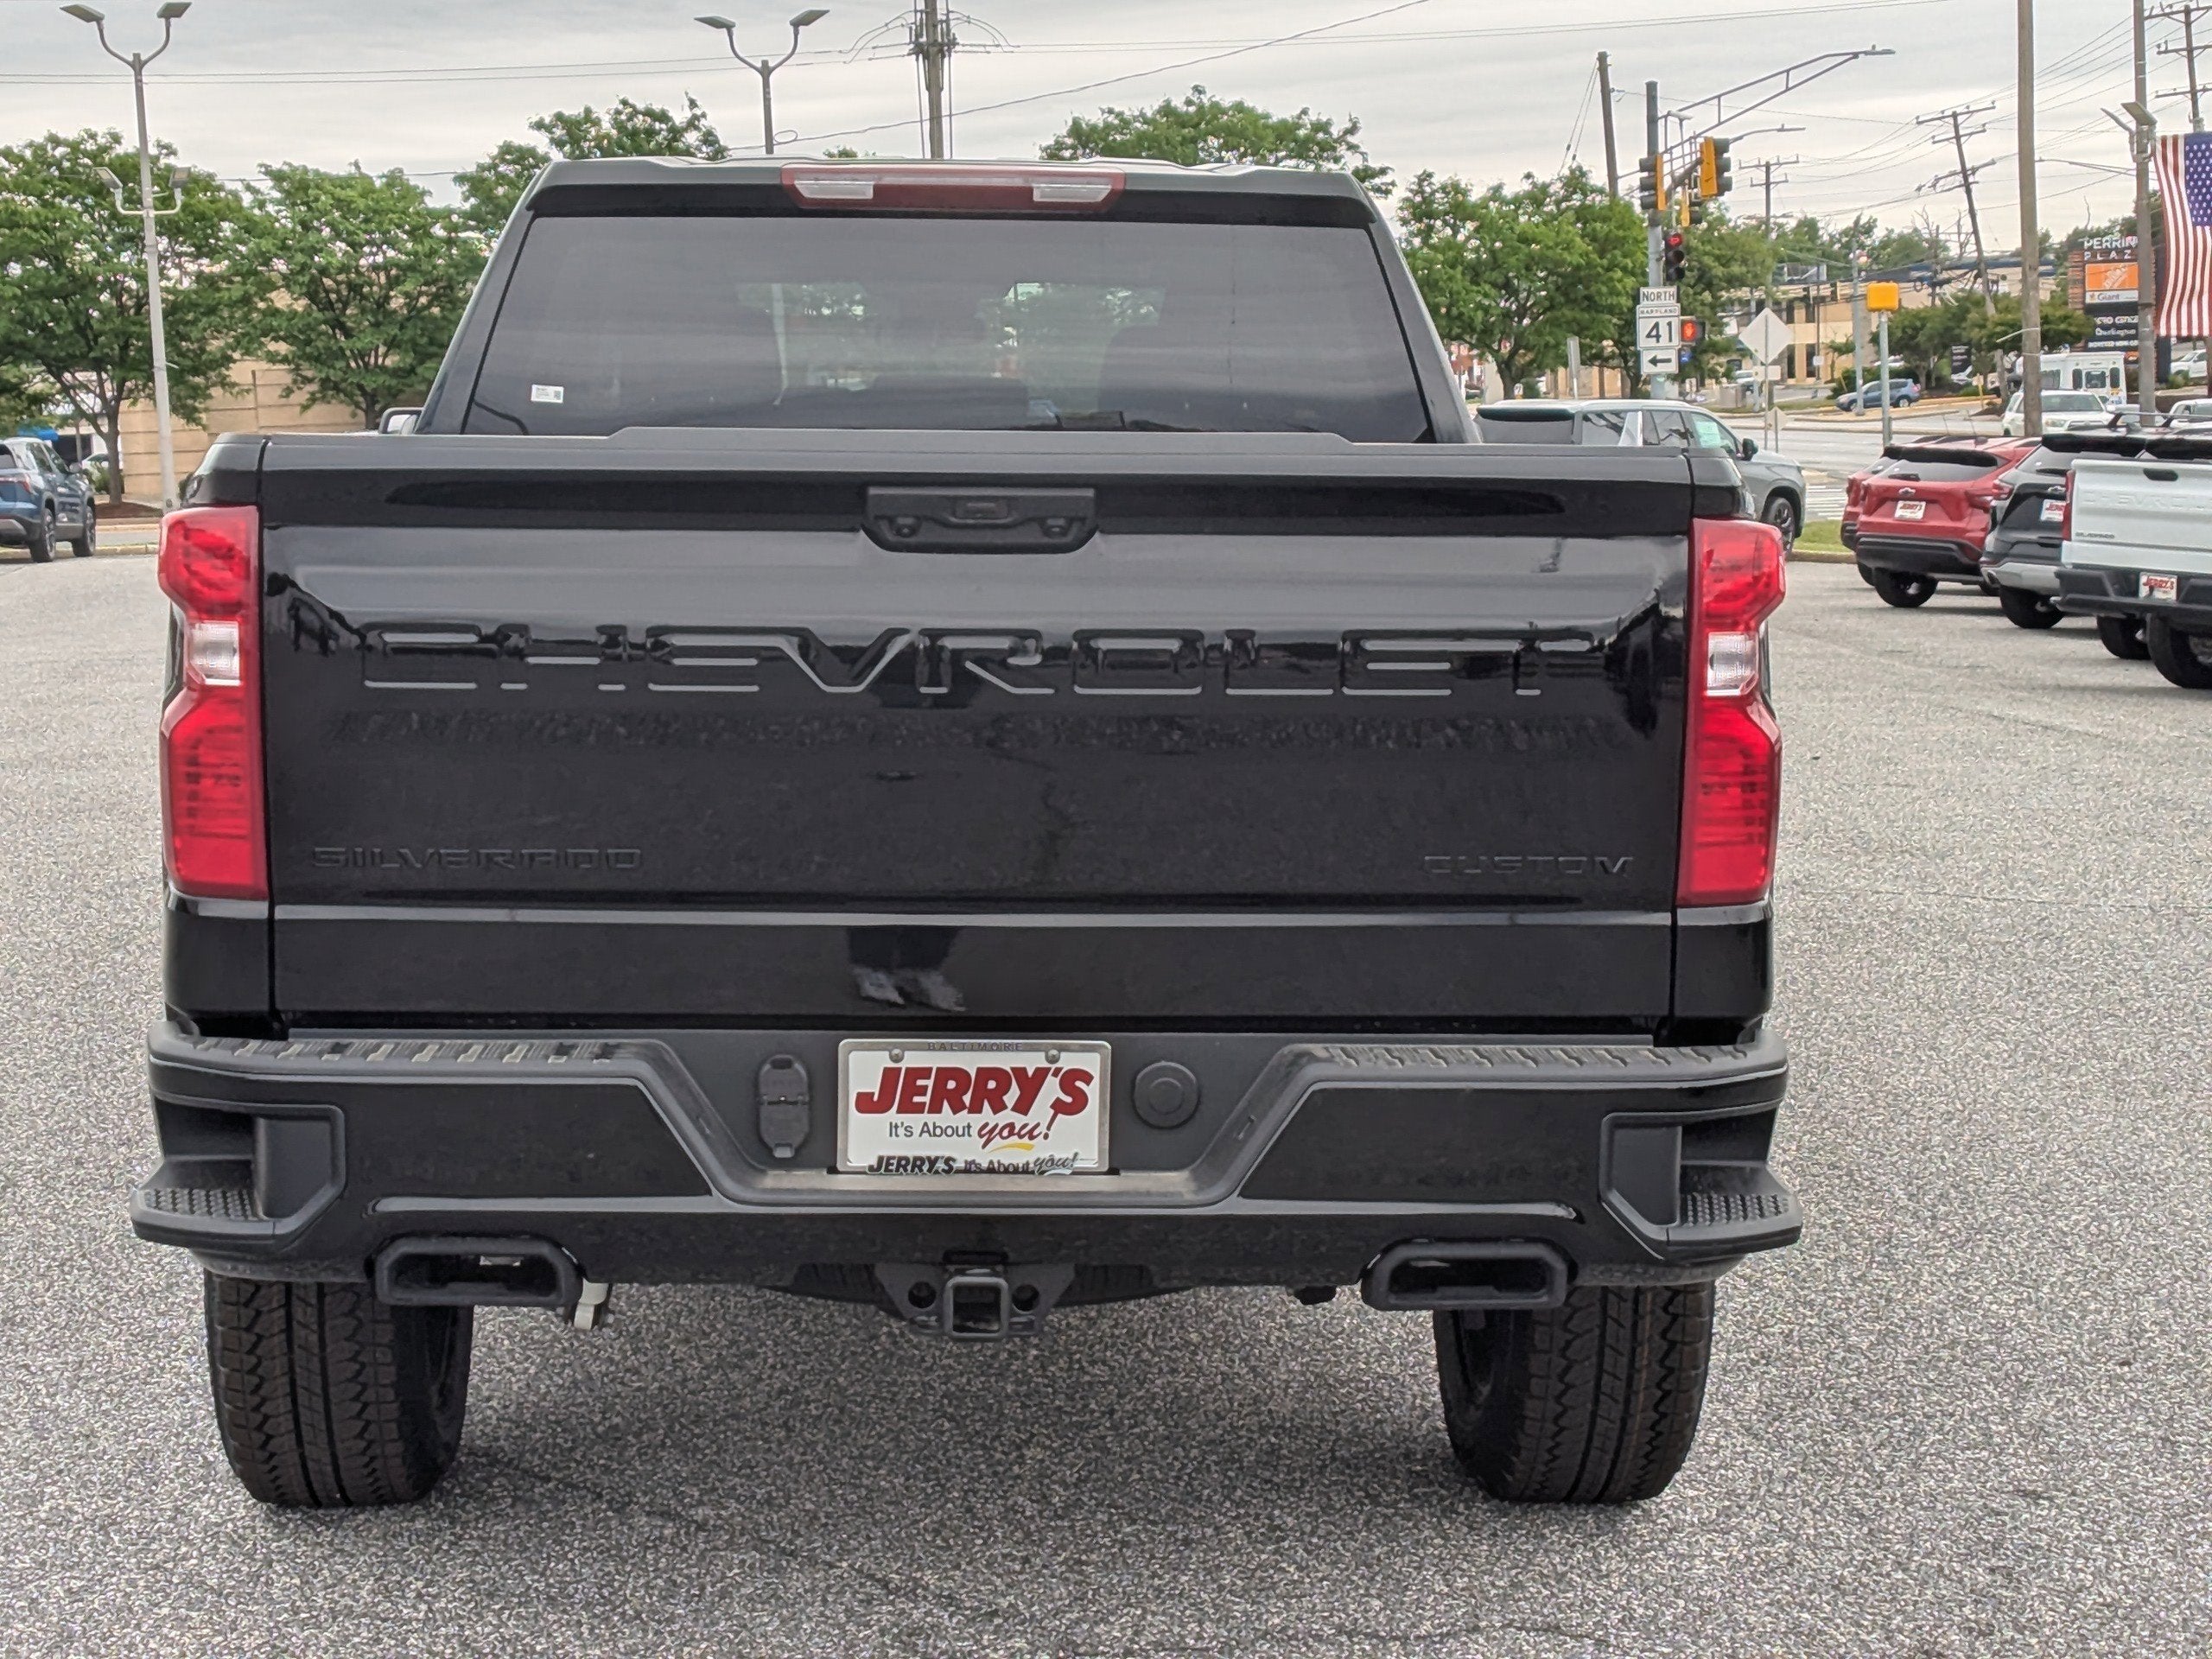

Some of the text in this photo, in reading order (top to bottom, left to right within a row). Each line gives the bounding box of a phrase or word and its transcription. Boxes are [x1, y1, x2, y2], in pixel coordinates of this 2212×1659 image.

[2083, 235, 2139, 250] PERRIN
[2083, 249, 2133, 261] PLAZ
[1643, 290, 1675, 302] NORTH
[1645, 321, 1673, 343] 41
[361, 622, 1597, 698] CHEVROLET
[312, 846, 642, 869] SILVERADO
[1422, 854, 1633, 874] CUSTOM
[927, 1042, 1023, 1052] BALTIMORE
[855, 1066, 1095, 1116] JERRY'S
[888, 1110, 1059, 1149] It's About you!
[867, 1152, 1079, 1175] JERRY'S It's About you!
